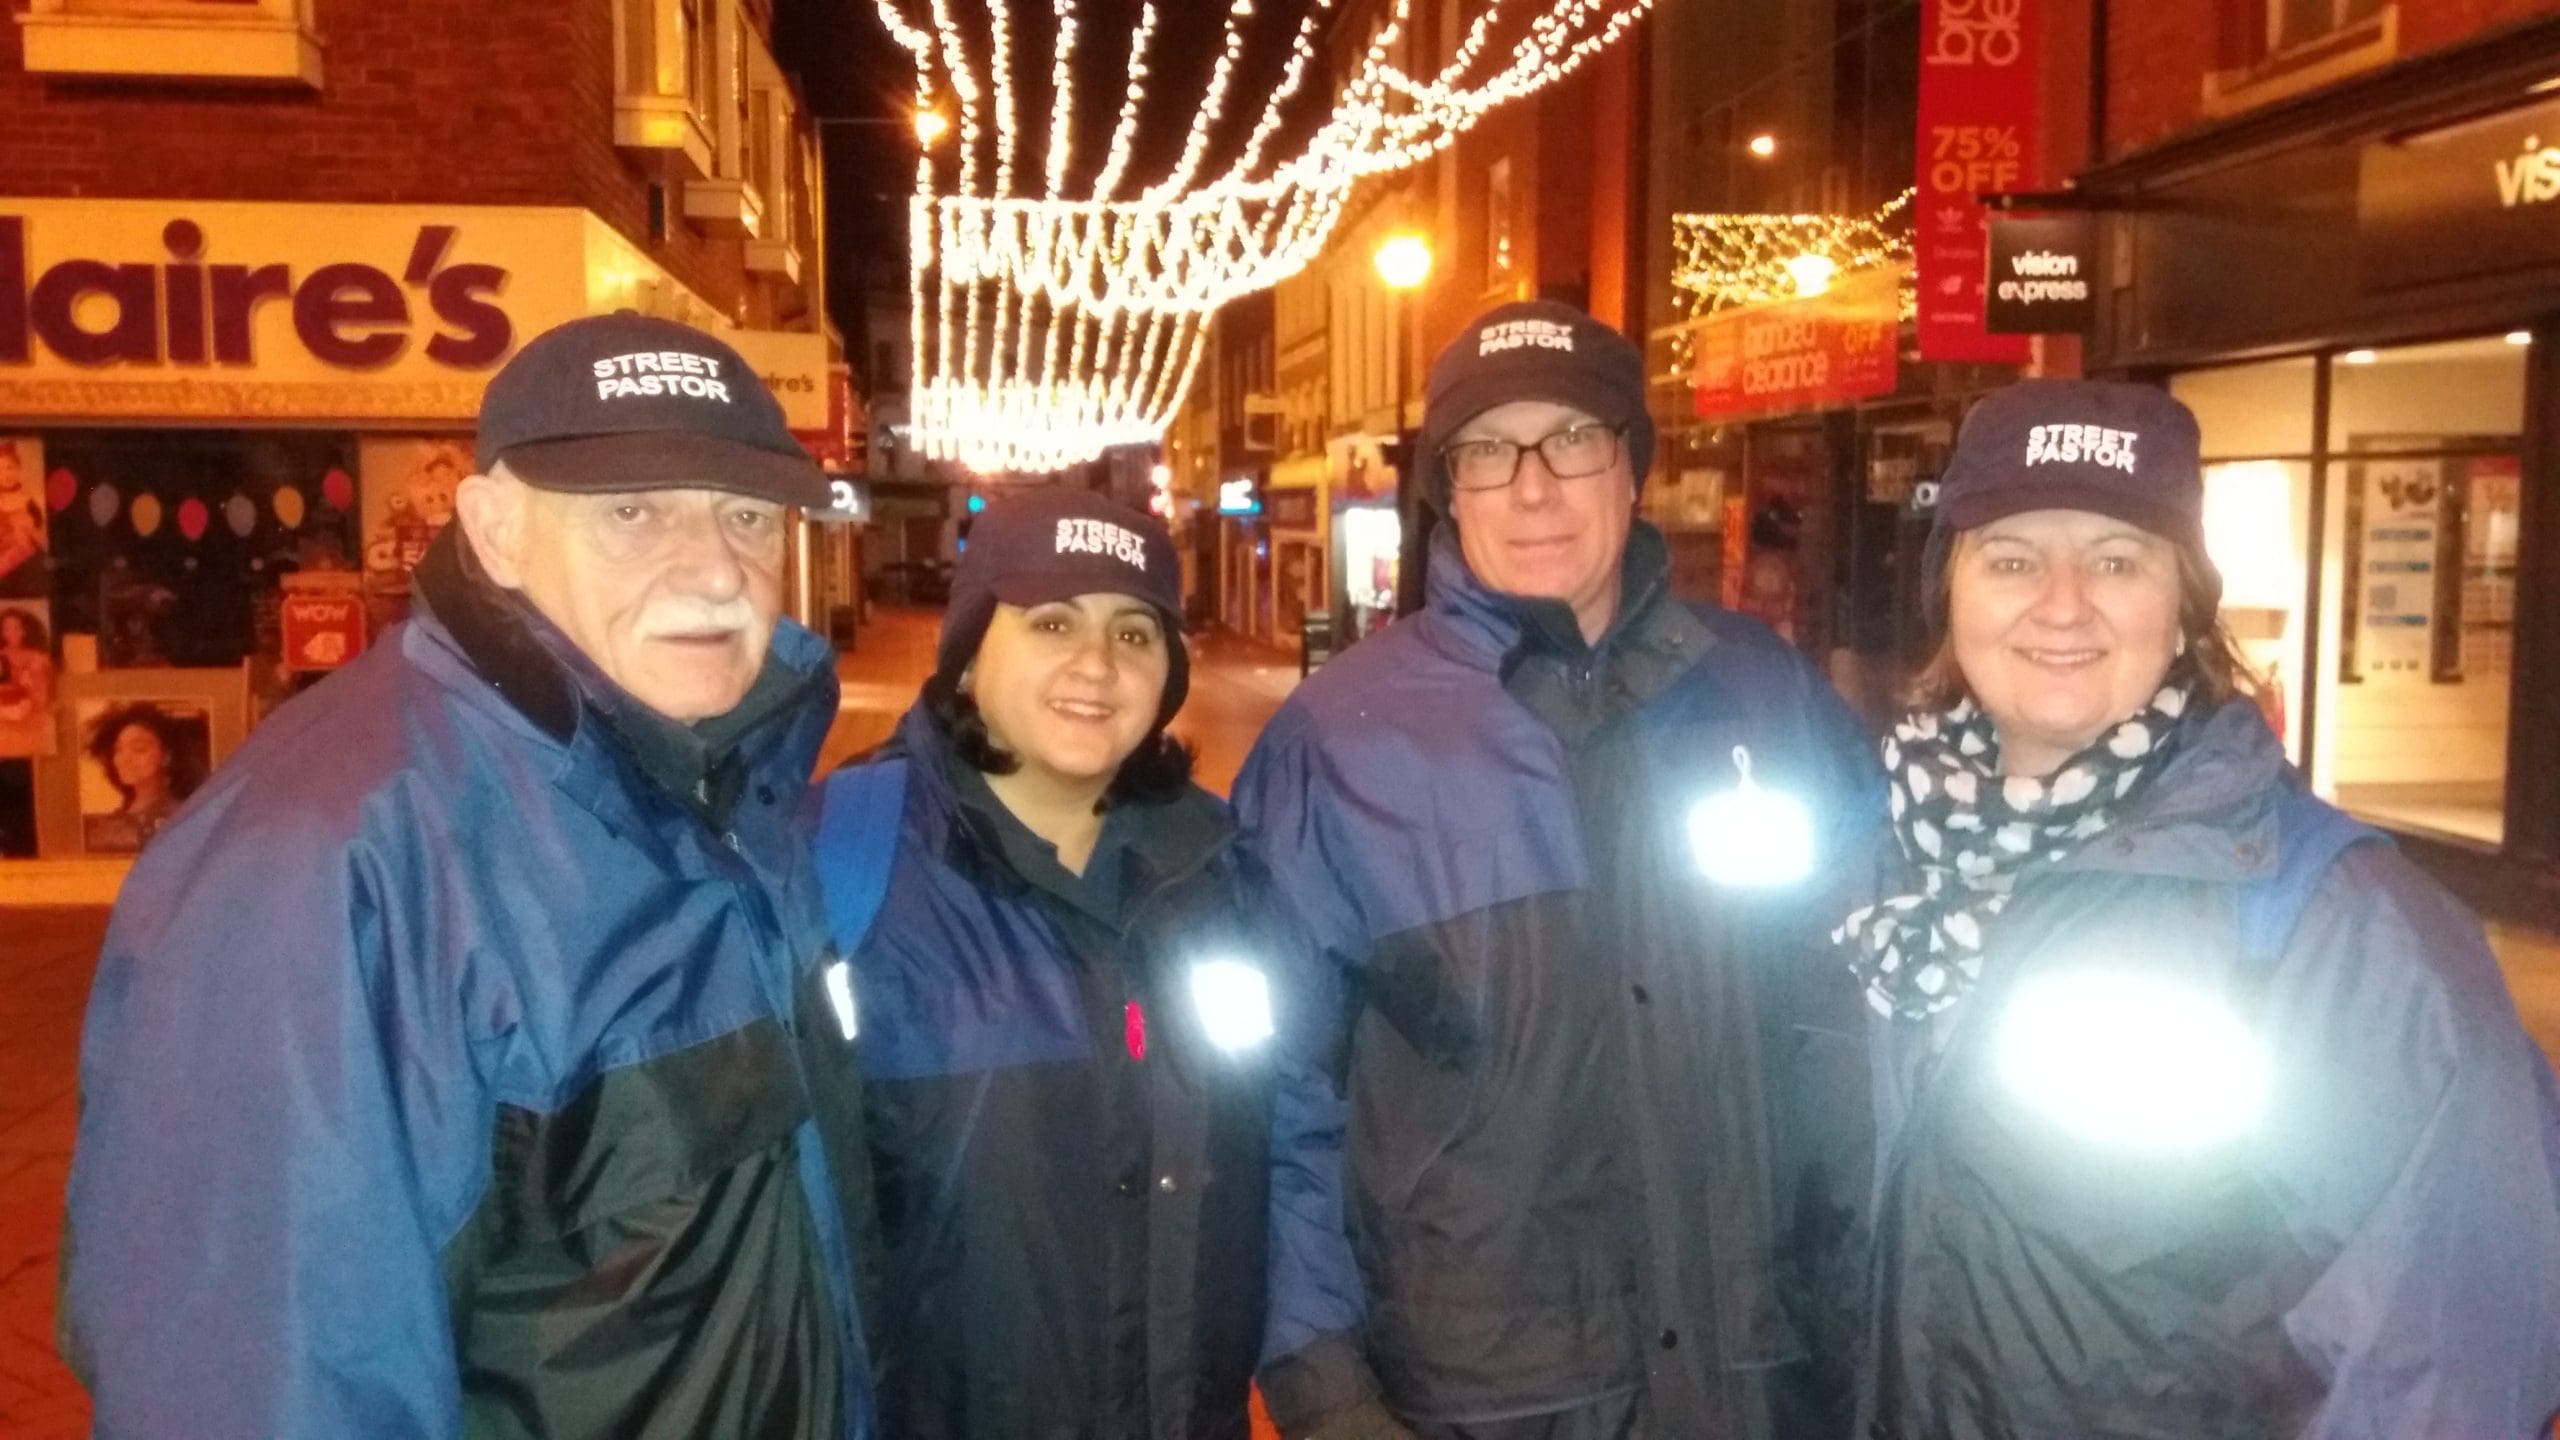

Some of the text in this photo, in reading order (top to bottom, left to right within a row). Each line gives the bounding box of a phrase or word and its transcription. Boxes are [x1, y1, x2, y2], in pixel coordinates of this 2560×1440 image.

[1932, 126, 2020, 159] 75%
[1931, 161, 2019, 192] OFF
[2012, 250, 2077, 275] vision
[1998, 281, 2088, 306] express
[1480, 320, 1573, 341] STREET
[1479, 334, 1573, 357] PASTOR
[593, 352, 720, 378] STREET
[597, 375, 731, 404] PASTOR
[2028, 423, 2138, 451] STREET
[2025, 442, 2135, 474] PASTOR
[1056, 519, 1146, 549] STREET
[1055, 535, 1146, 571] PASTOR
[293, 604, 349, 621] WOW
